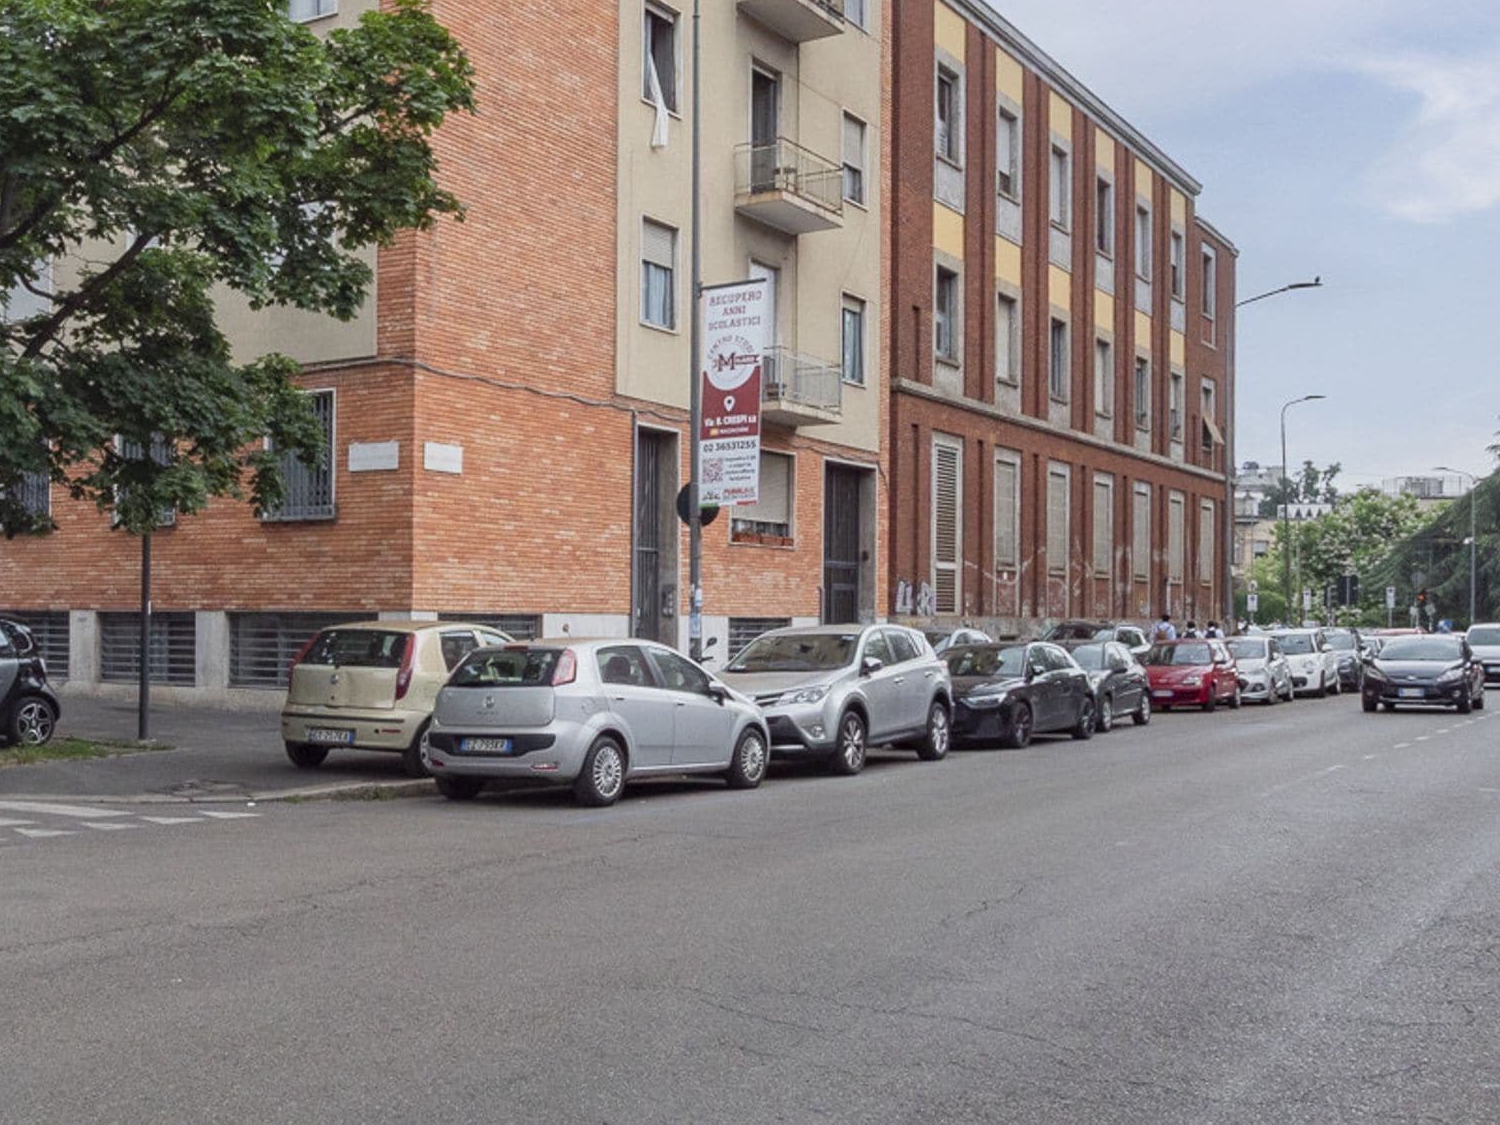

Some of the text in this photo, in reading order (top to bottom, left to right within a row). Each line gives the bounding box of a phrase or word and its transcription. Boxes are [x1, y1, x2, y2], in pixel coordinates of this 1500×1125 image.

[708, 289, 763, 307] RECUPERO
[722, 305, 746, 316] ANNI
[708, 315, 761, 331] SCOLASTICI
